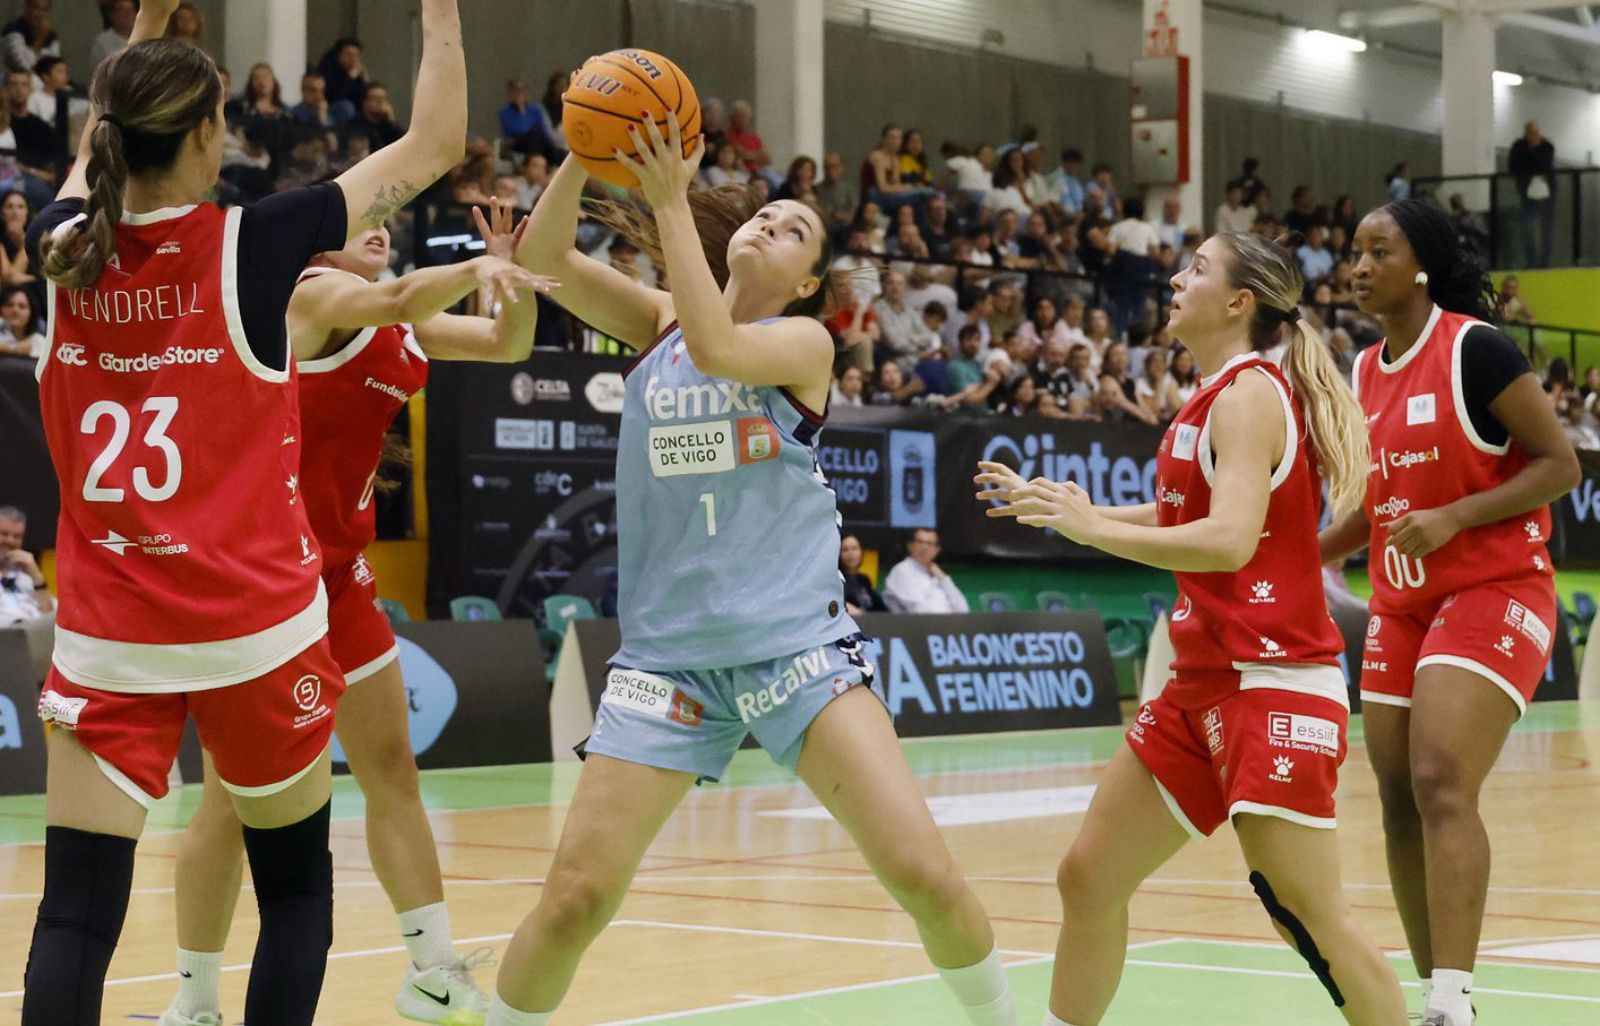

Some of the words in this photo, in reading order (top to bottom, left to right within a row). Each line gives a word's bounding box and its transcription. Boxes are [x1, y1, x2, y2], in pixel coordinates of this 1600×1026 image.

[67, 282, 204, 324] VENDRELL
[80, 397, 182, 502] 23
[653, 432, 725, 449] CONCELLO
[661, 453, 678, 466] DE
[682, 449, 716, 463] VIGO
[1391, 446, 1439, 468] Cajasol
[700, 493, 716, 536] 1
[139, 533, 171, 544] GRUPO
[143, 543, 188, 556] INTERBUS
[928, 631, 1084, 667] BALONCESTO
[611, 674, 667, 698] CONCELLO
[611, 686, 625, 698] DE
[628, 689, 656, 706] VIGO
[736, 647, 831, 723] Recalvi
[936, 669, 1093, 712] FEMENINO
